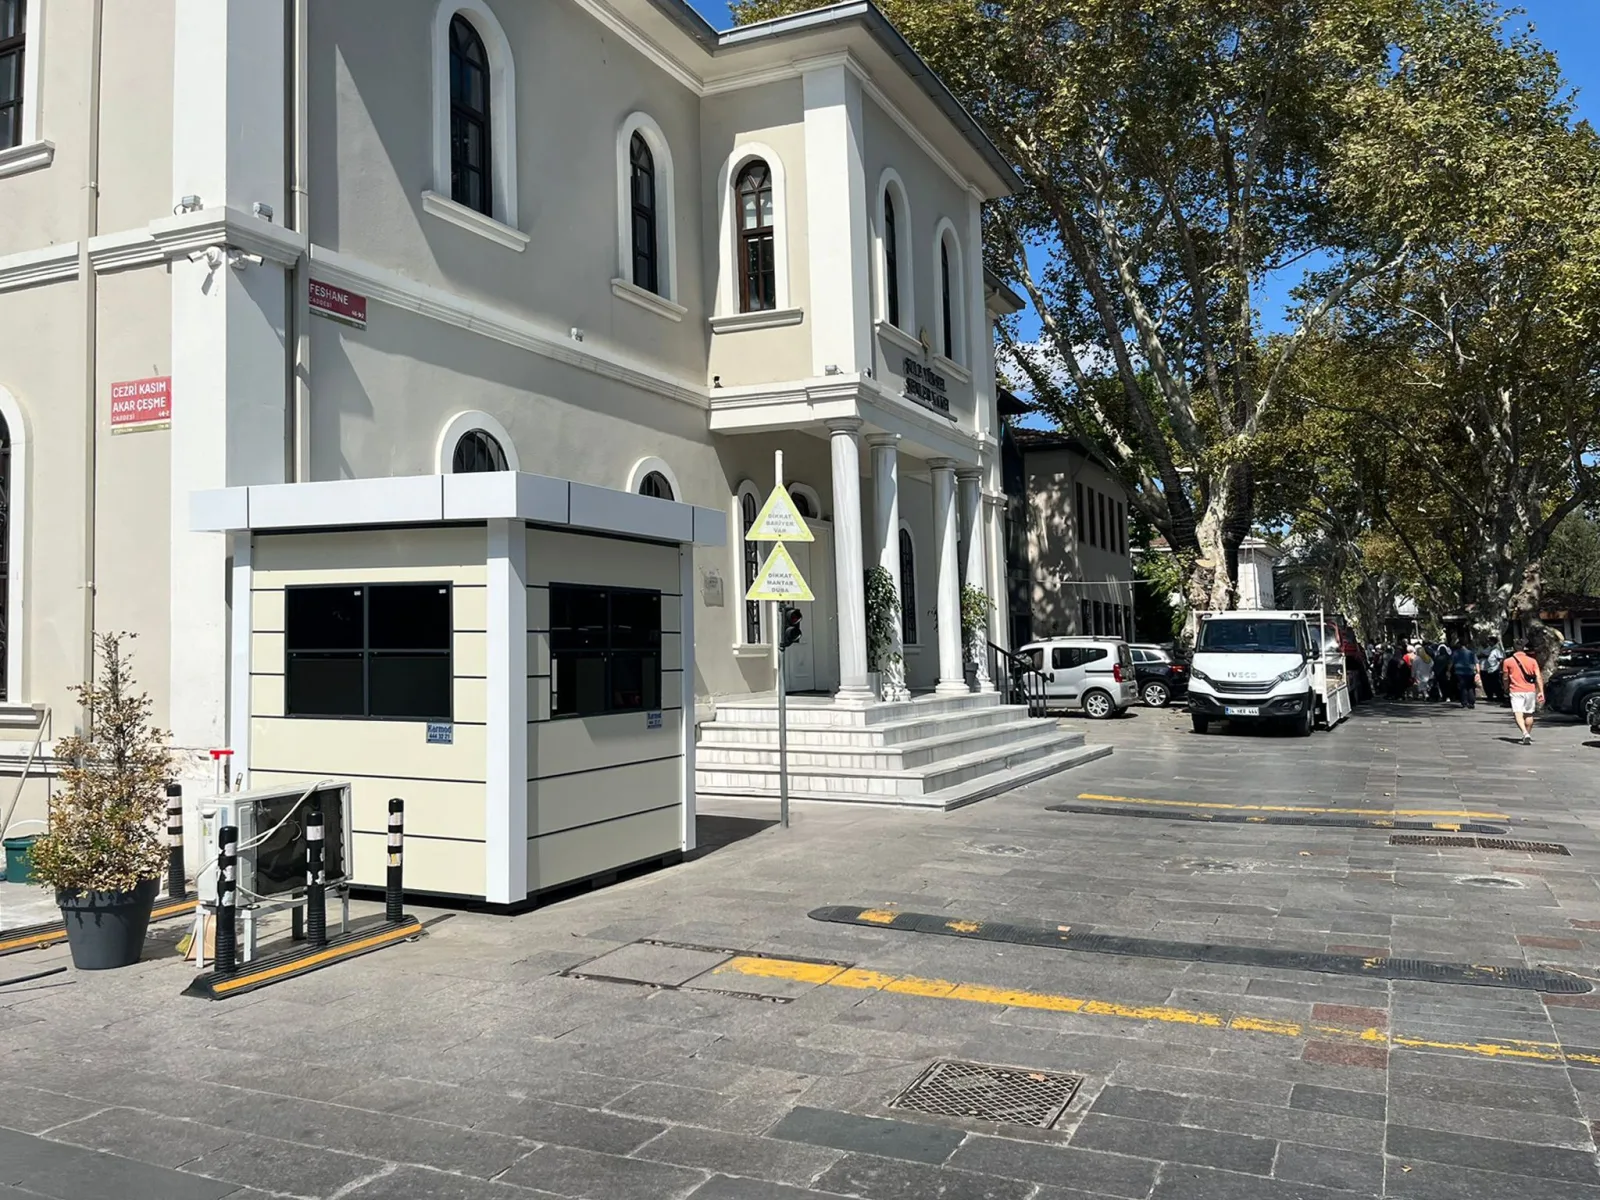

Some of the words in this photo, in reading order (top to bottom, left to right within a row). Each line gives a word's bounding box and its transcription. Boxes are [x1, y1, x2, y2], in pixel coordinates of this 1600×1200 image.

[310, 283, 349, 306] FESHANE
[113, 383, 137, 398] CEZRİ
[139, 381, 166, 395] KASIM
[113, 400, 135, 412] AKAR
[136, 397, 166, 412] ÇEŞME
